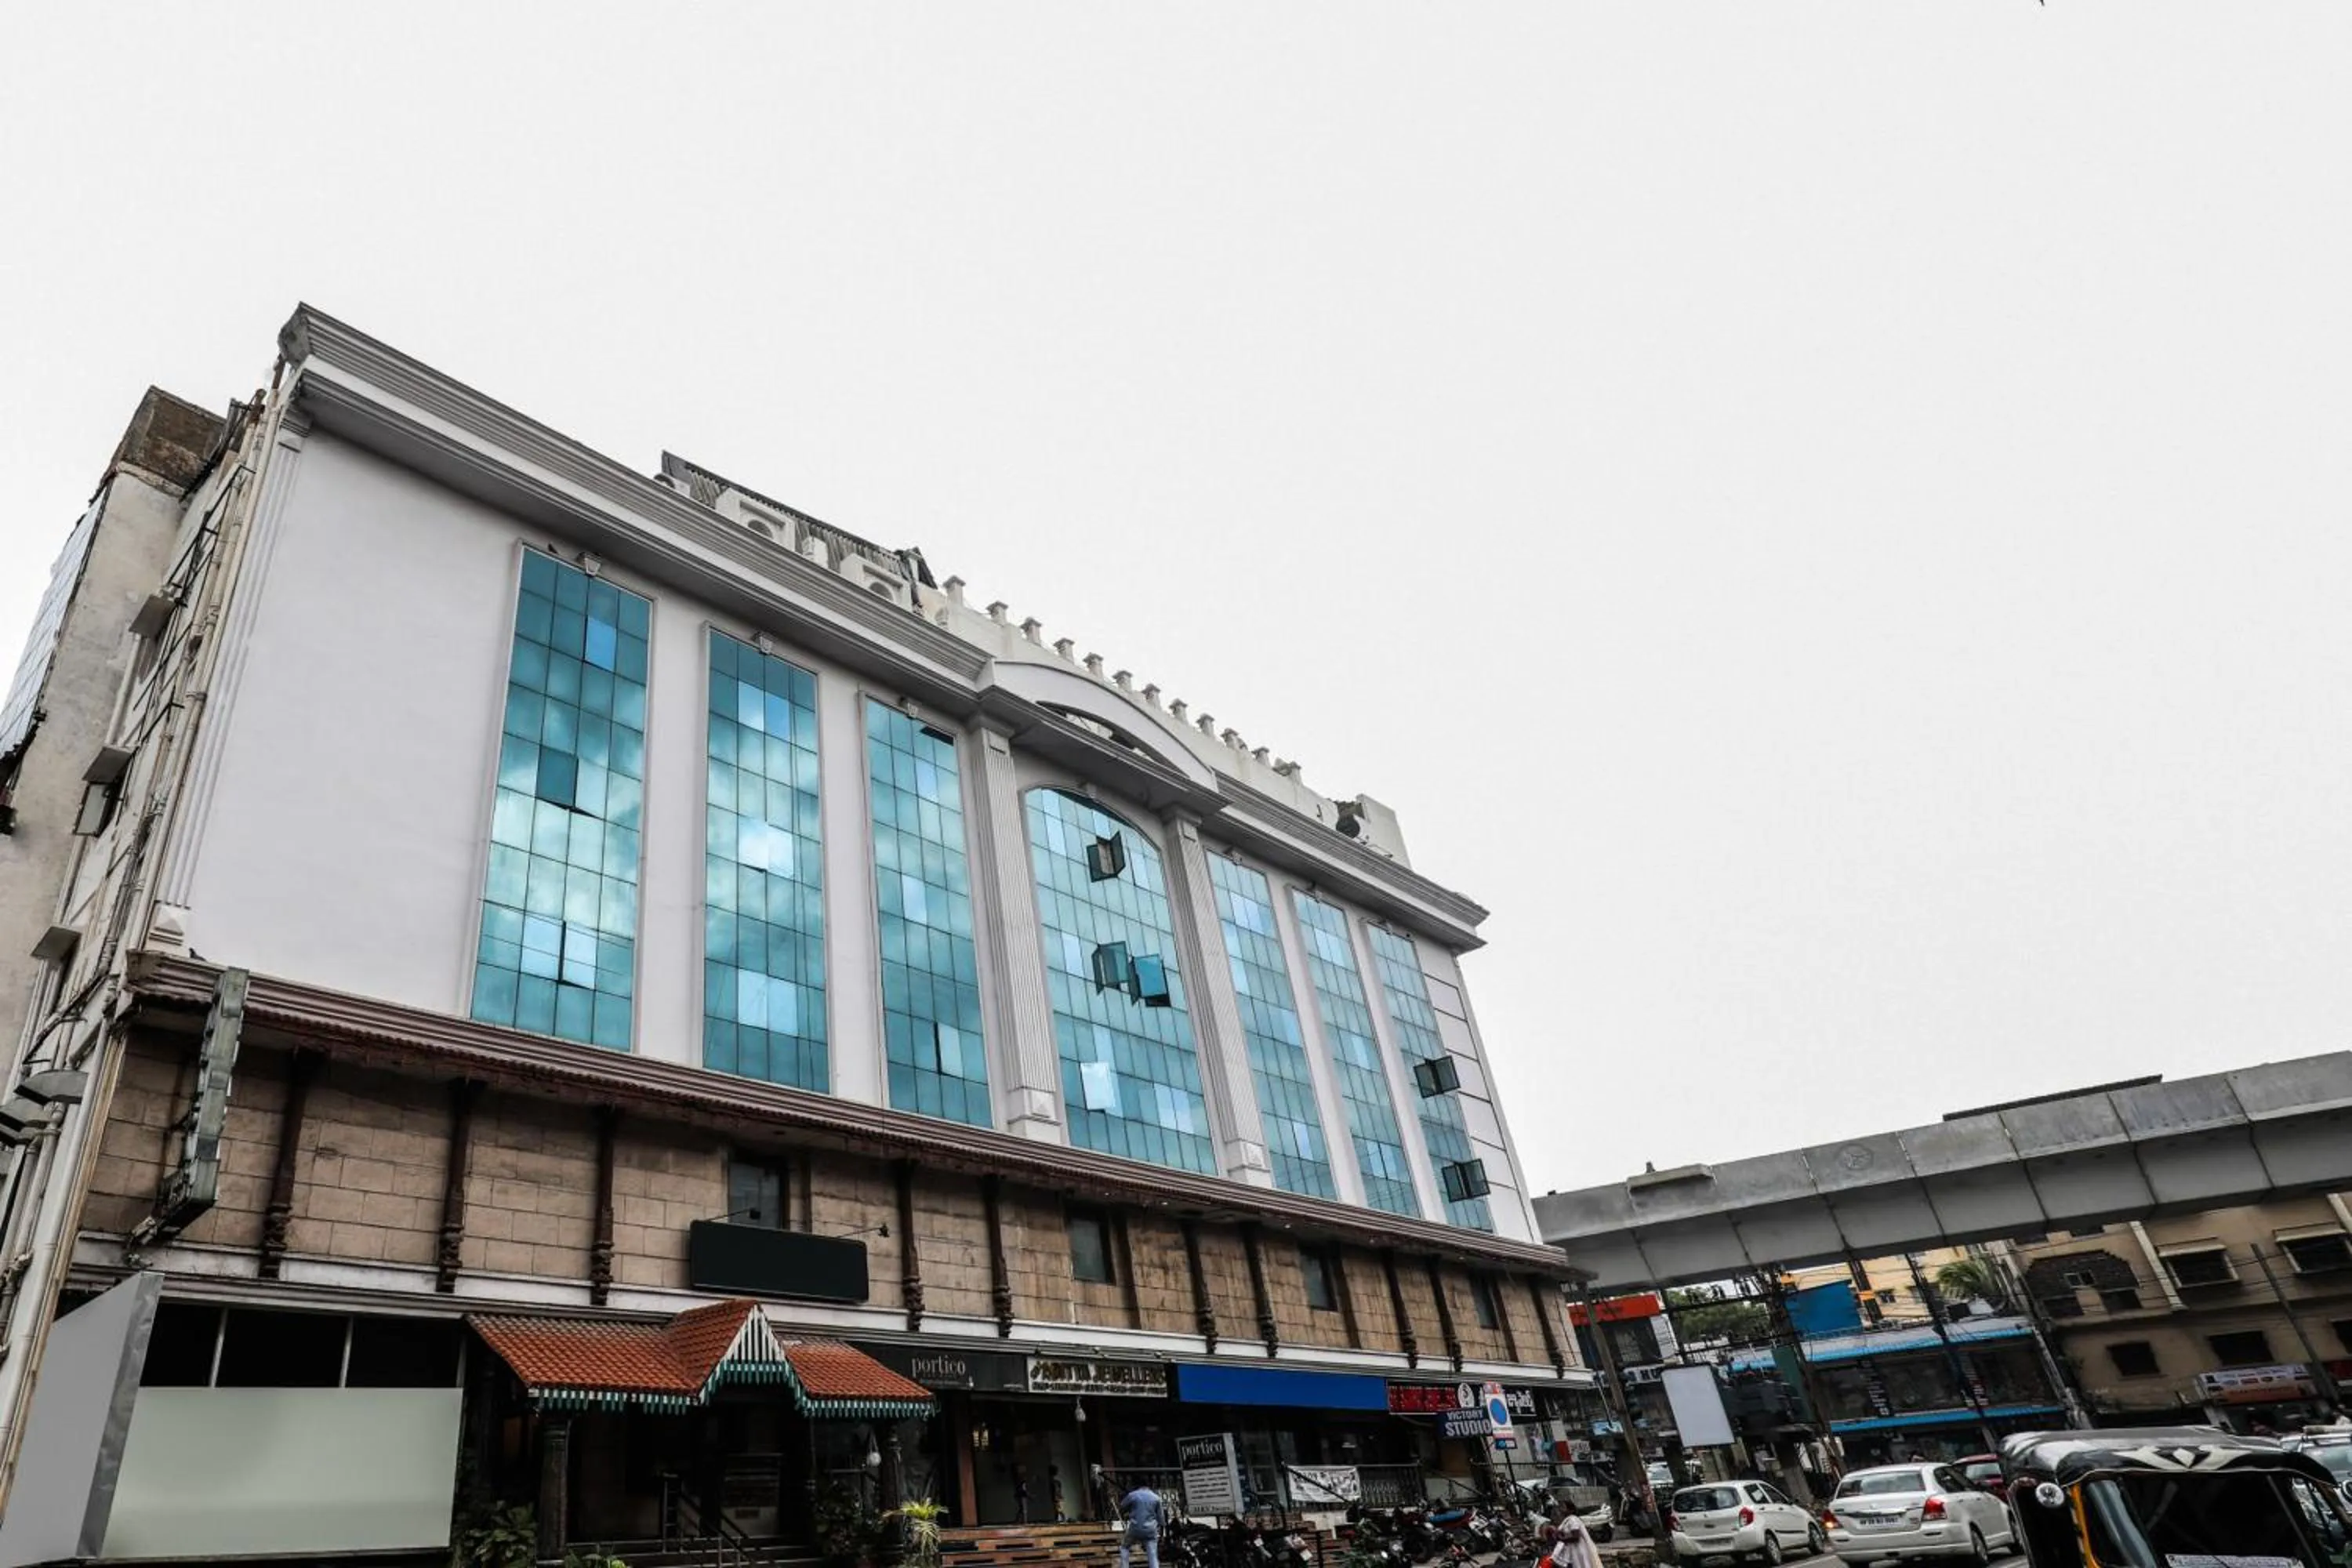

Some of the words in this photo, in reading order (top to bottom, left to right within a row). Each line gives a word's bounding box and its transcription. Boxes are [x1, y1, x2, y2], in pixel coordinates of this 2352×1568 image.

[911, 1354, 966, 1378] portico
[1446, 1410, 1483, 1421] VICTORY
[1445, 1419, 1492, 1437] STUDIO
[1181, 1439, 1223, 1461] portico
